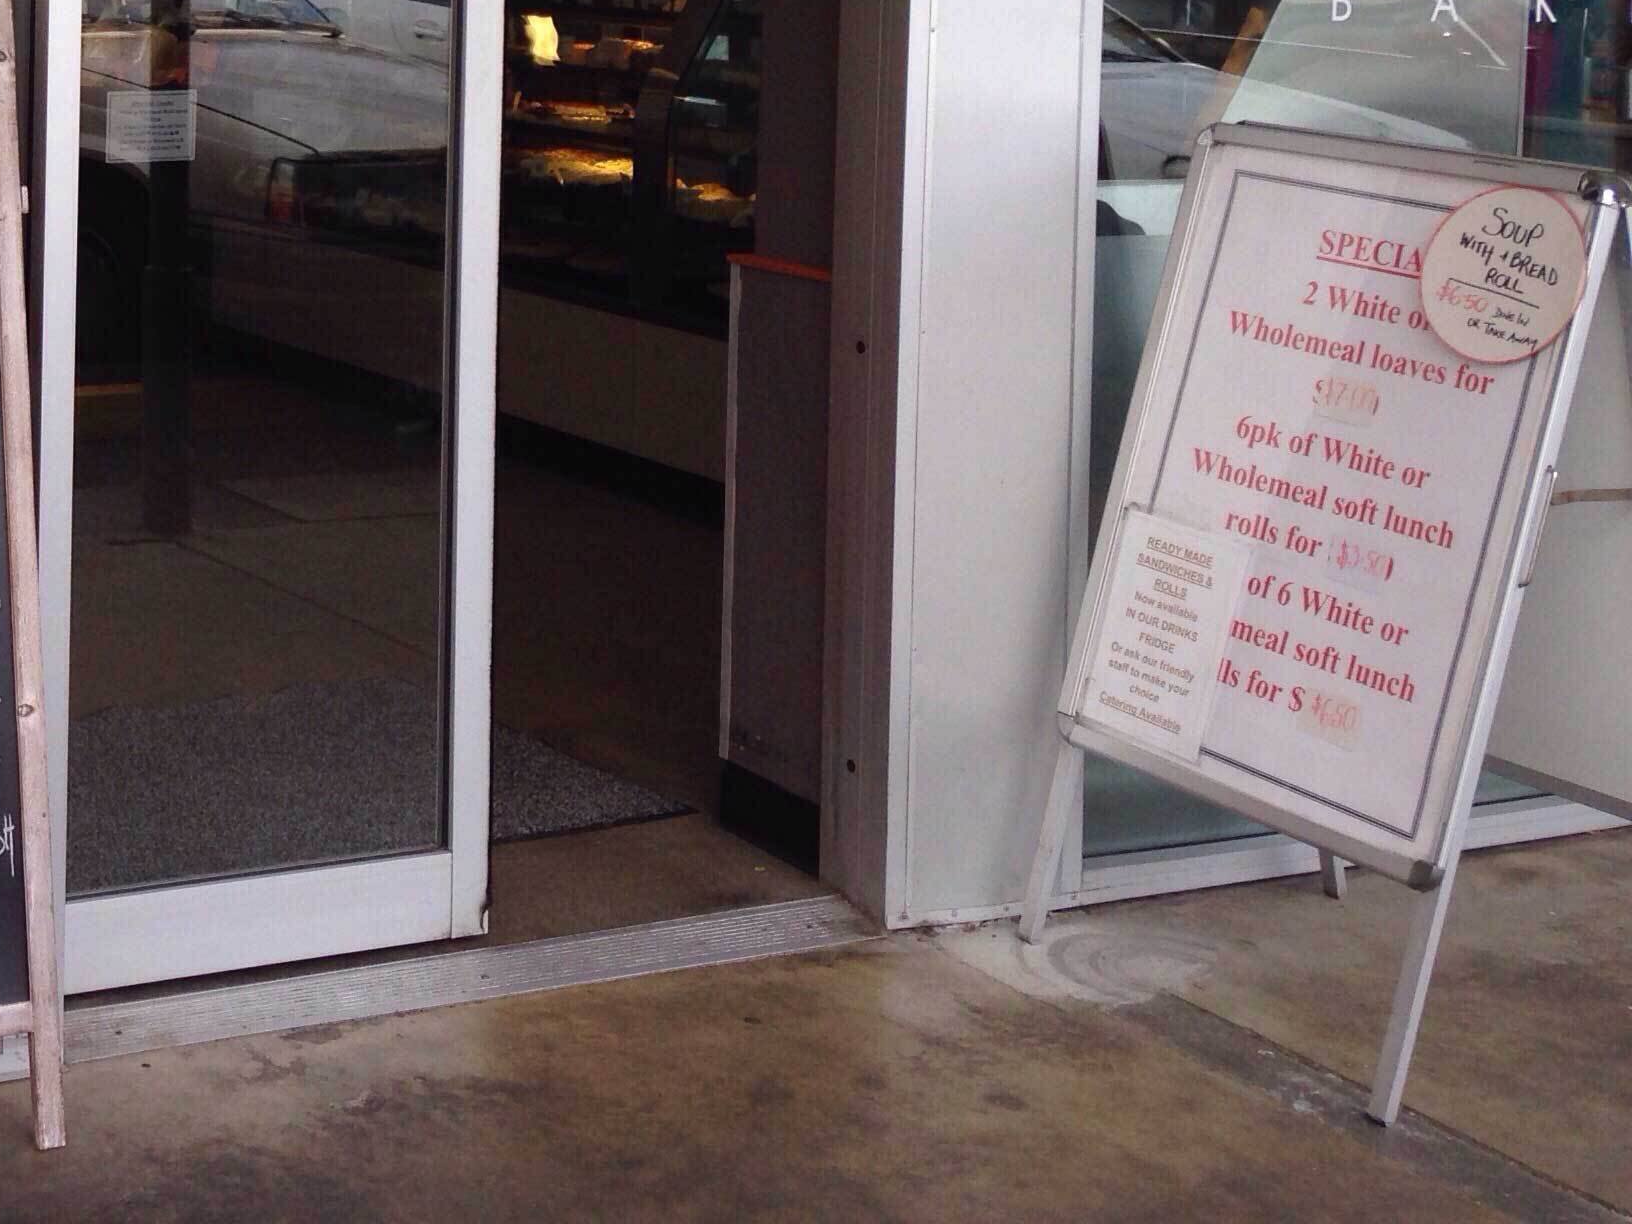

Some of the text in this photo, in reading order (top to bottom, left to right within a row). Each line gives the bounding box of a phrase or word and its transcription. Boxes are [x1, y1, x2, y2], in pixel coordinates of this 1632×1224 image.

[1482, 207, 1545, 248] SOUP
[1317, 229, 1423, 276] SPECIA
[1459, 232, 1495, 266] WITH
[1509, 251, 1558, 286] BREAD
[1303, 280, 1318, 305] 2
[1327, 283, 1402, 324] White
[1485, 267, 1524, 295] ROLL
[1229, 309, 1495, 397] Wholemeal loaves for
[1236, 414, 1431, 491] 6pk of White or
[1192, 449, 1456, 550] Wholemeal soft lunch
[1147, 536, 1214, 567] READY MADE
[1224, 509, 1278, 545] rolls
[1285, 525, 1324, 557] for
[1136, 553, 1205, 582] SANDWICHES
[1153, 578, 1188, 600] ROLLS
[1125, 607, 1199, 642] IN OUR DRINKS
[1156, 599, 1199, 623] available
[1247, 575, 1409, 646] of 6 White or
[1139, 632, 1176, 654] FRIDGE
[1231, 620, 1416, 704] meal soft lunch
[1245, 669, 1283, 702] for
